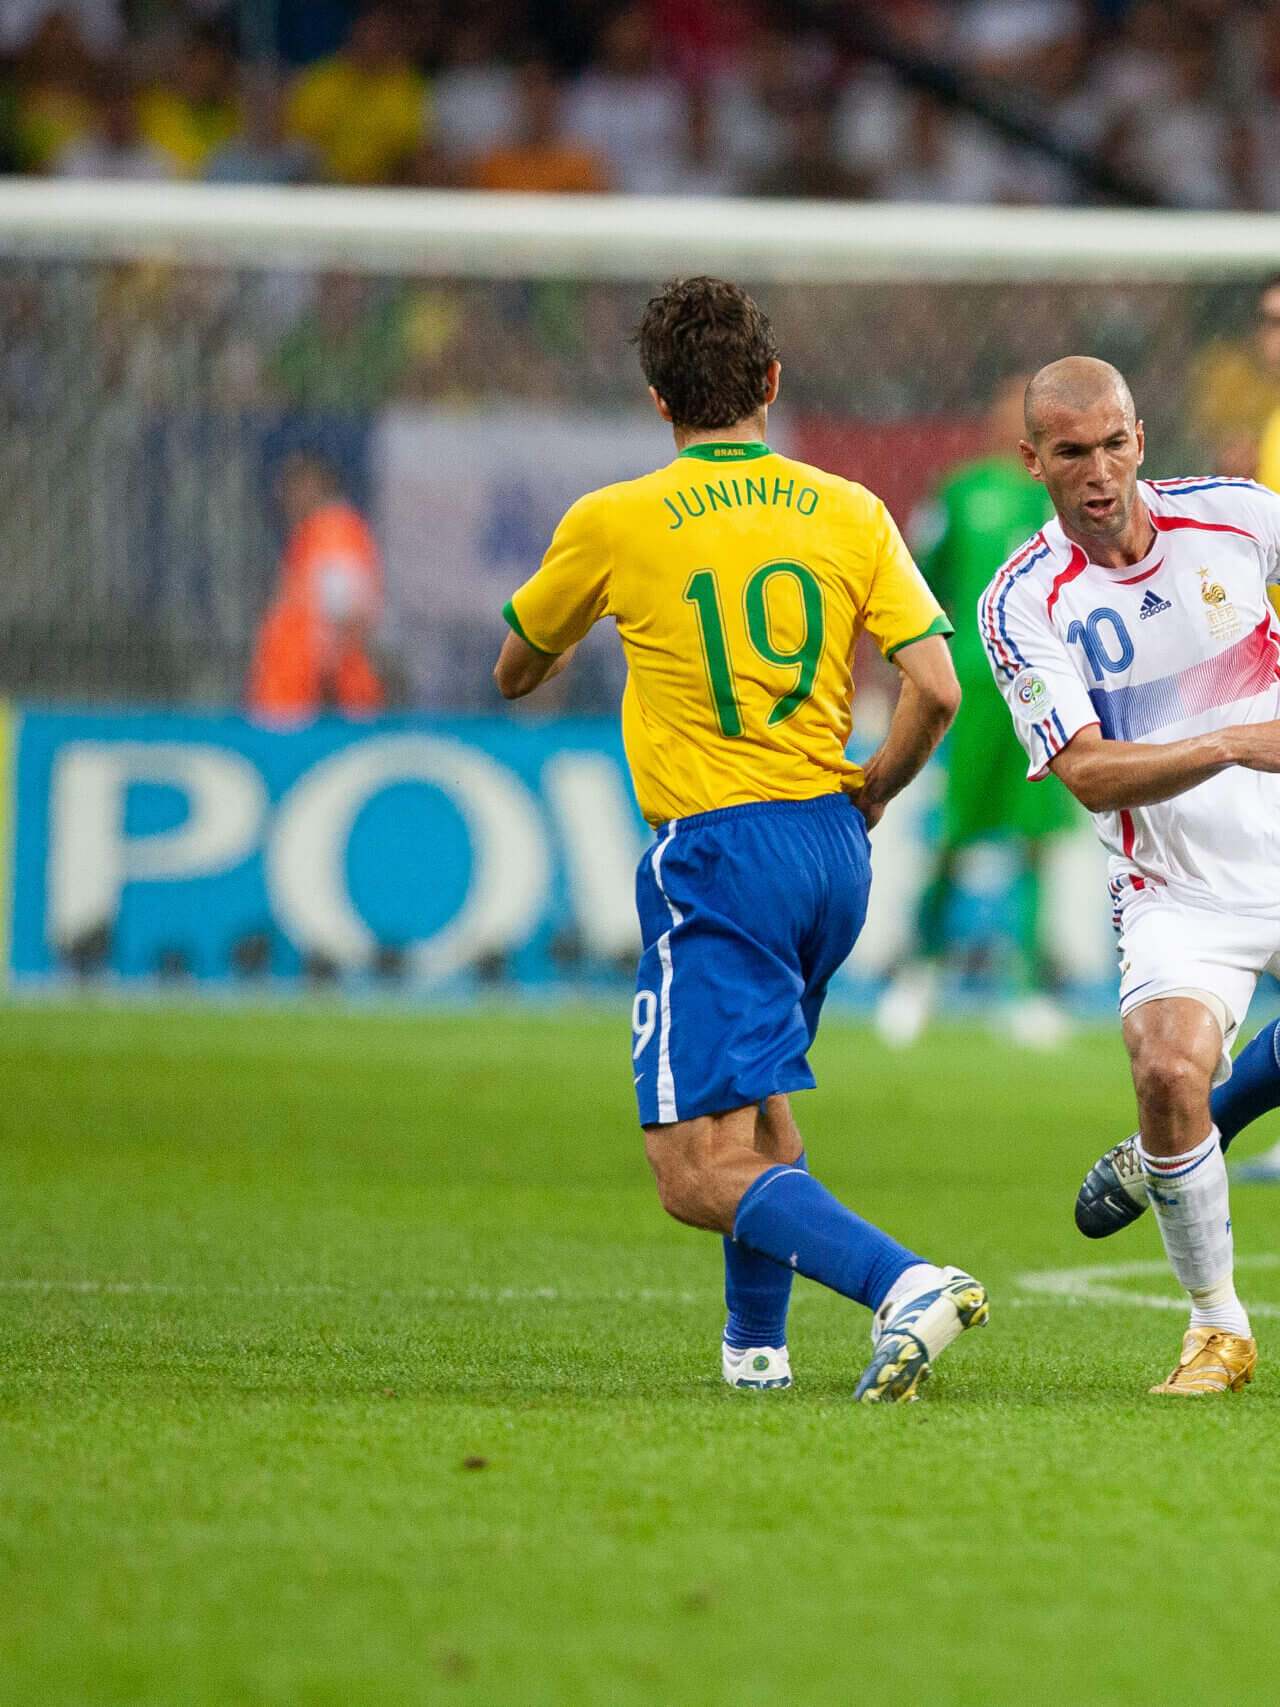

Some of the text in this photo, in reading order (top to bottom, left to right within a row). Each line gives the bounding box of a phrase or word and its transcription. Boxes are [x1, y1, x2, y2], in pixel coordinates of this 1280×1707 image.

[714, 448, 747, 457] BRASIL
[663, 477, 819, 530] JUNINHO
[1139, 600, 1172, 620] adidas
[682, 558, 827, 739] 19
[1066, 607, 1135, 682] 10
